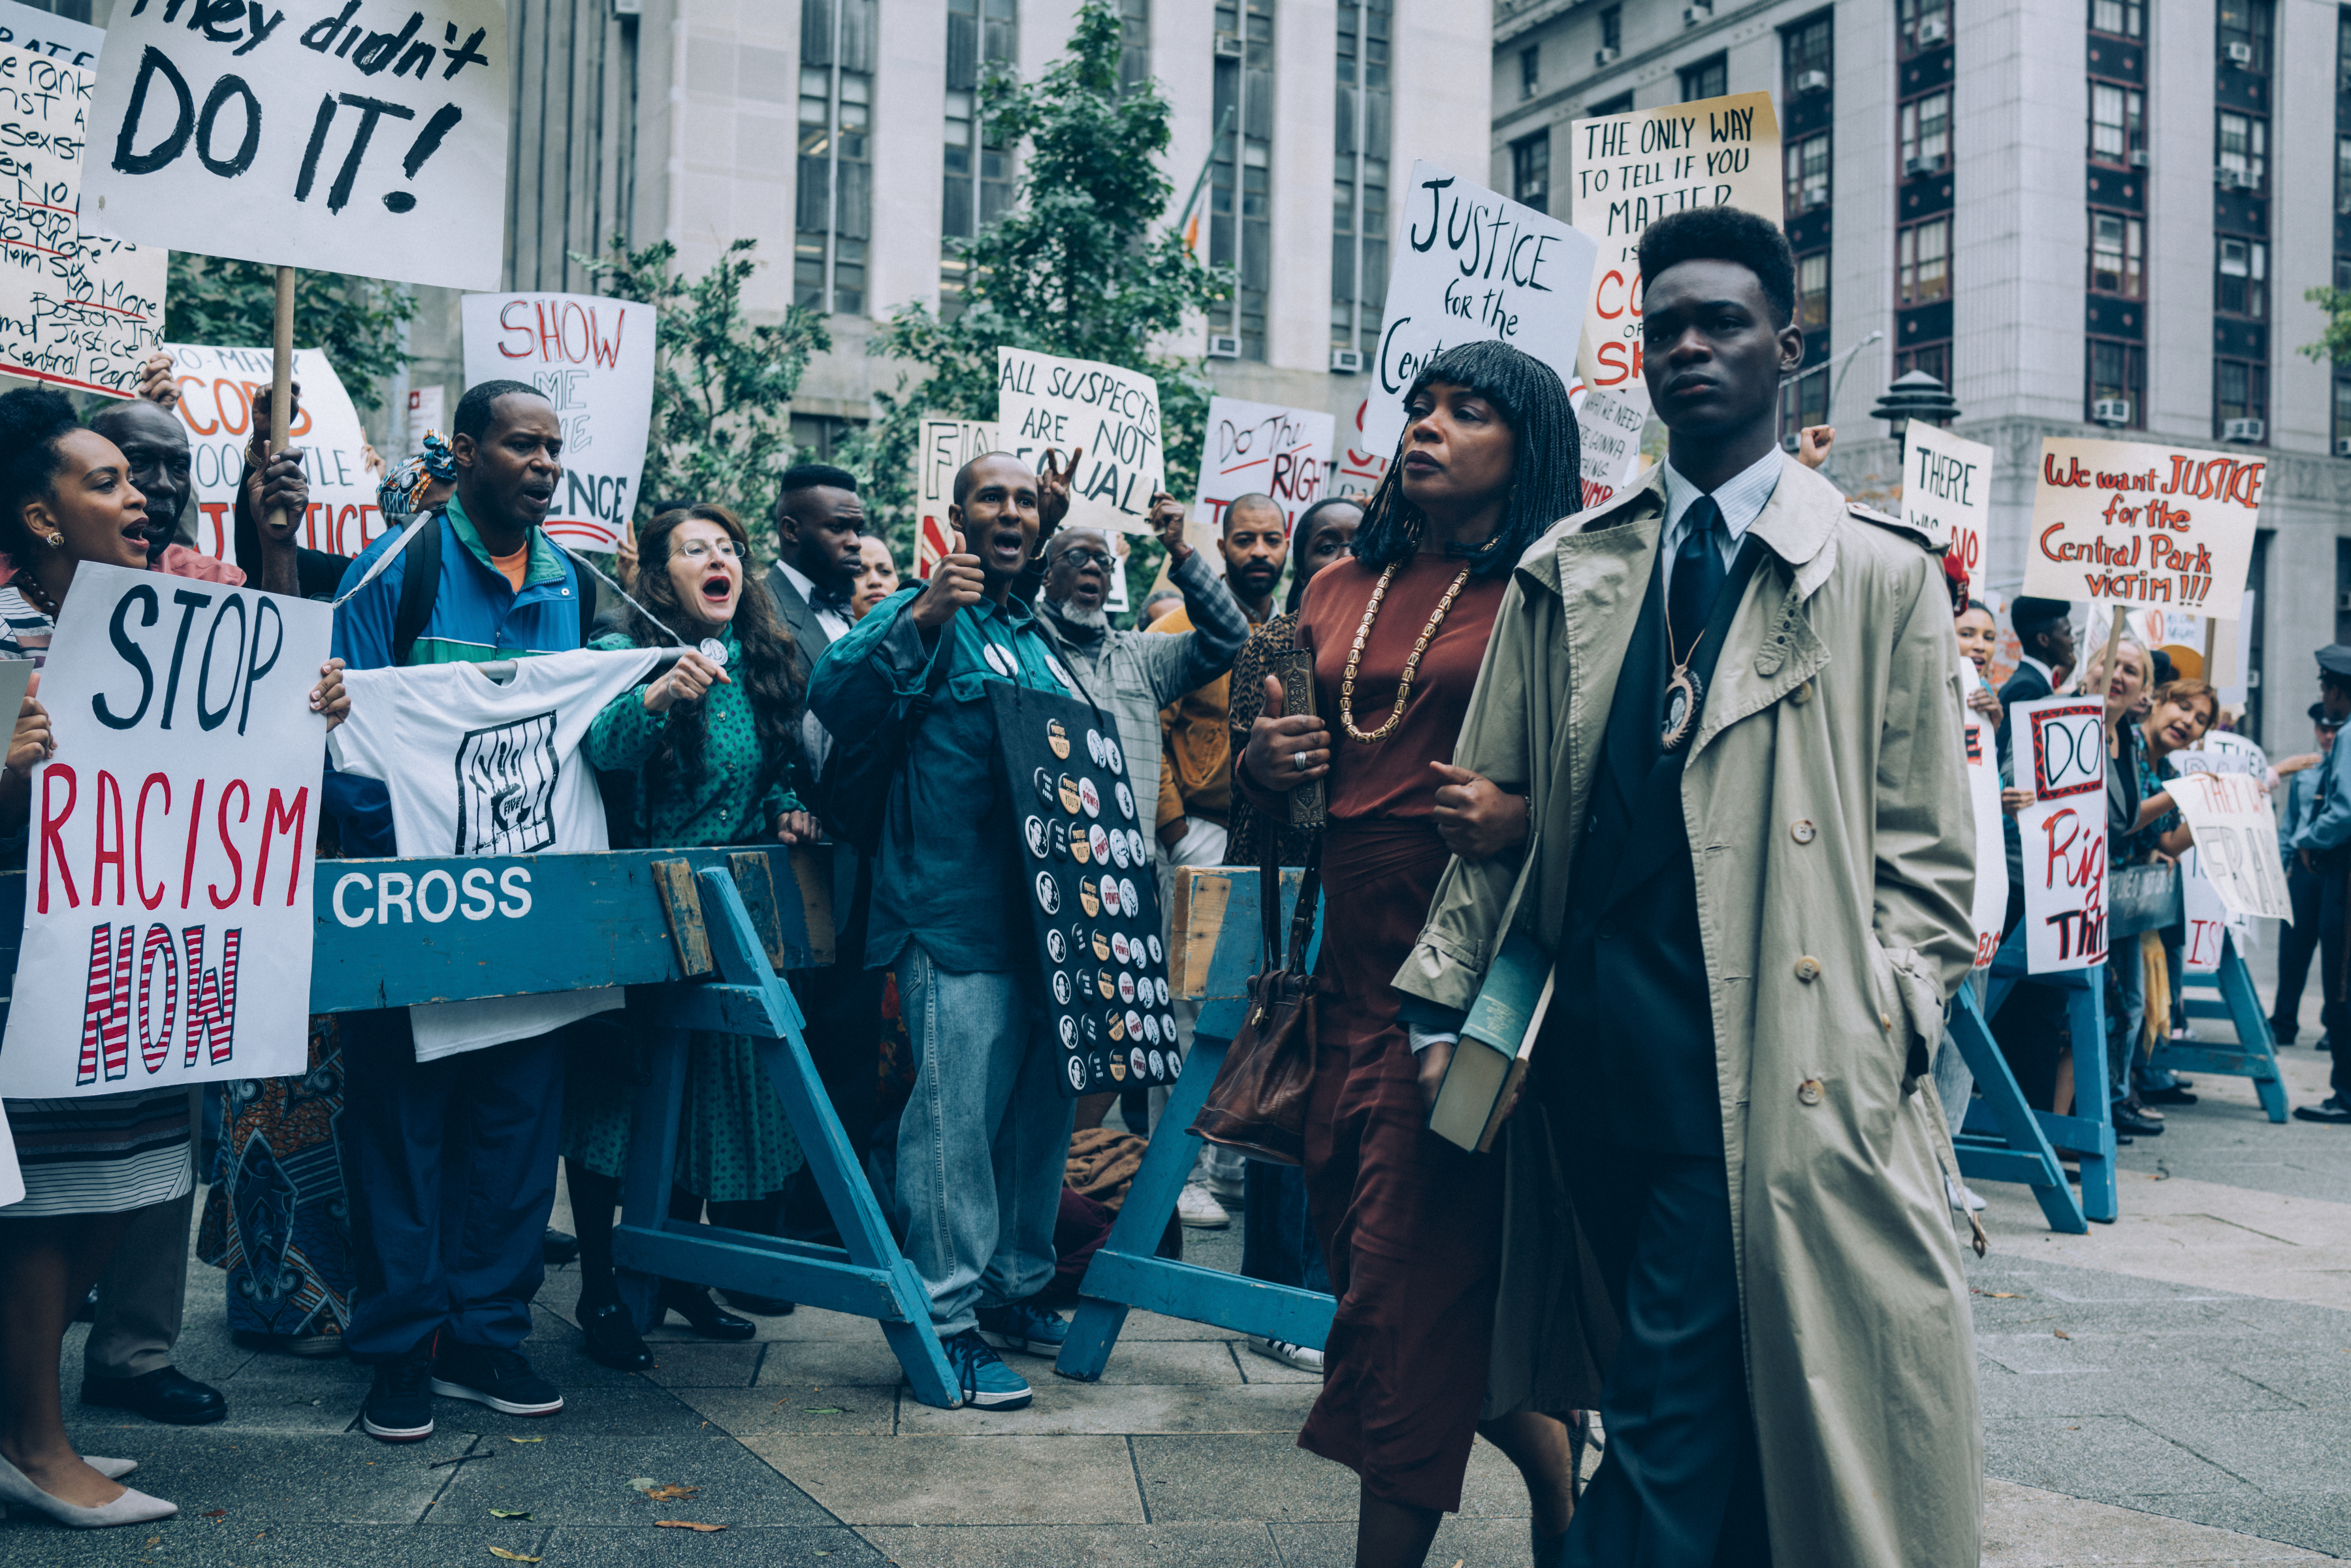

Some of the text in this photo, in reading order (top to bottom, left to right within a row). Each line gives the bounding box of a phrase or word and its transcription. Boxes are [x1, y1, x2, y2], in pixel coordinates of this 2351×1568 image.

[130, 0, 488, 80] ey didn't
[112, 44, 462, 216] DO IT!
[1585, 106, 1753, 160] THE ONLY WAY
[1578, 147, 1749, 199] TO TELL IF YOU
[498, 299, 625, 370] SHOW
[533, 369, 590, 411] ME
[999, 357, 1157, 437] ALL SUSPECTS
[1020, 407, 1156, 470] ARE NOT
[1220, 420, 1255, 464] Do
[1917, 446, 1977, 507] THERE
[2045, 453, 2090, 488] We
[2096, 468, 2159, 492] want
[2102, 494, 2191, 532] for the
[2041, 522, 2212, 574] Central Park
[91, 584, 284, 737] STOP
[2044, 718, 2102, 786] DO
[37, 763, 309, 914] RACISM
[504, 801, 521, 816] FIVE
[332, 866, 533, 928] CROSS
[76, 921, 242, 1087] NOW
